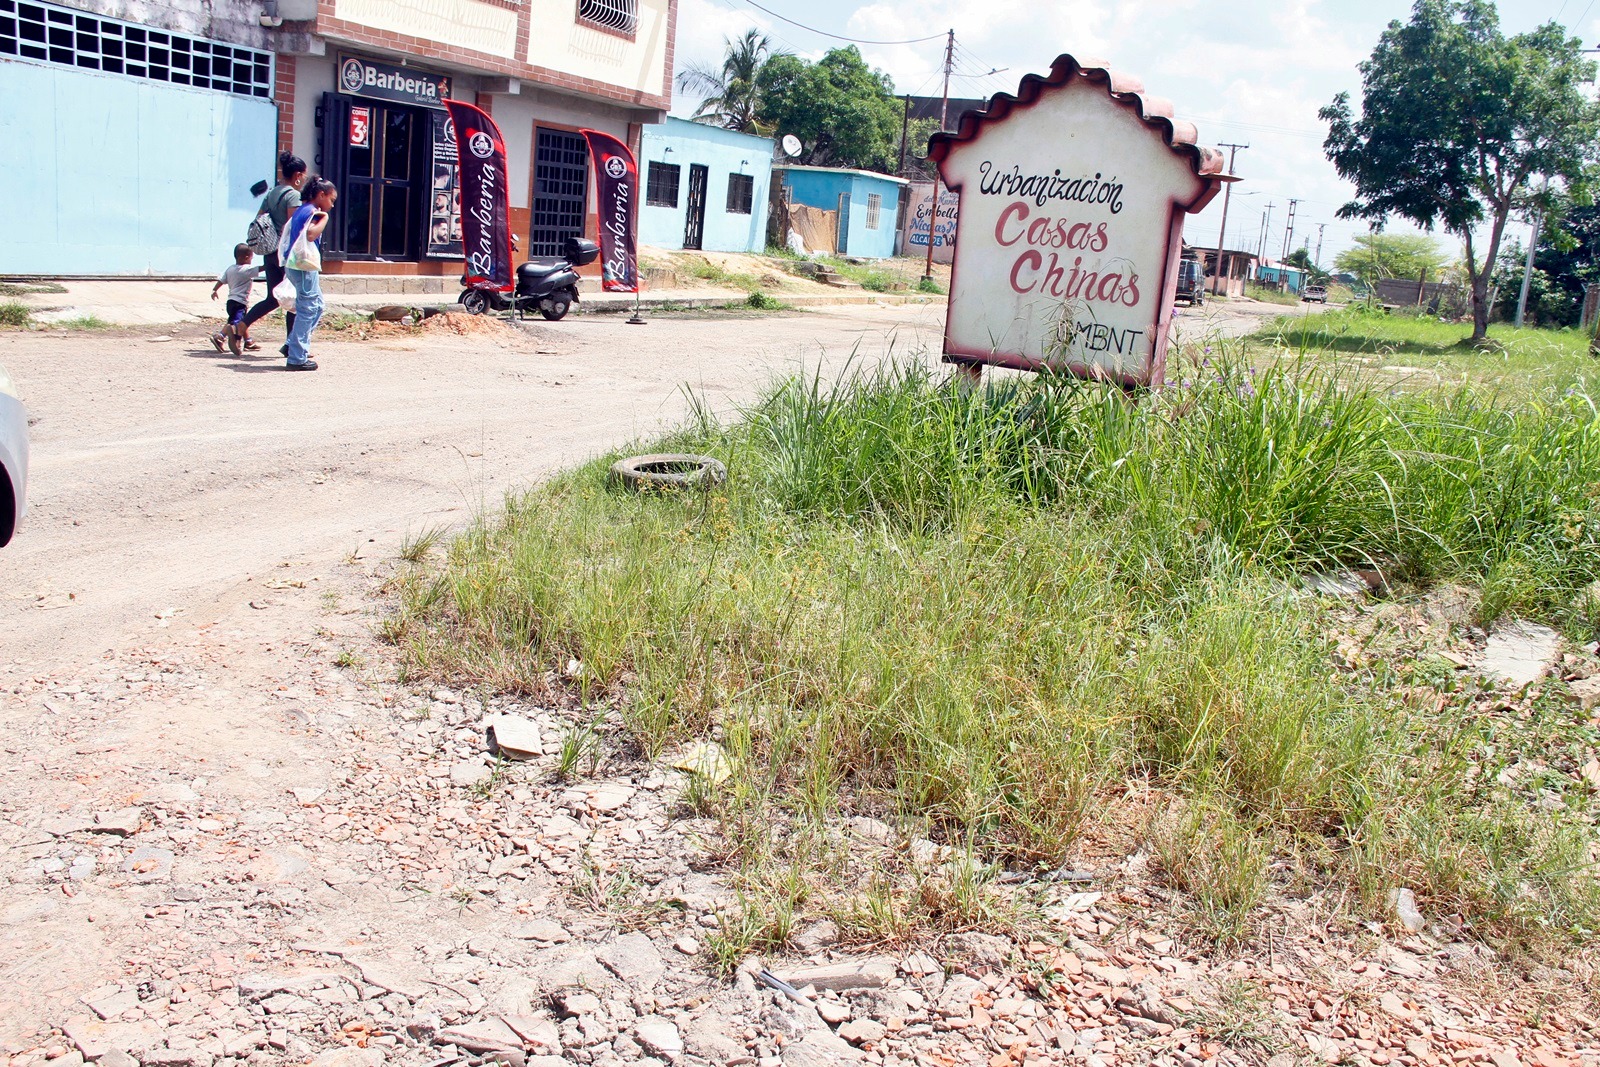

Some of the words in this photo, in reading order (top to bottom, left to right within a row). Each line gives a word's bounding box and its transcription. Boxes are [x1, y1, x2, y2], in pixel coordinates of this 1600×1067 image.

[979, 161, 1123, 214] Urbanización
[994, 201, 1108, 252] Casas
[1010, 249, 1140, 307] Chinas
